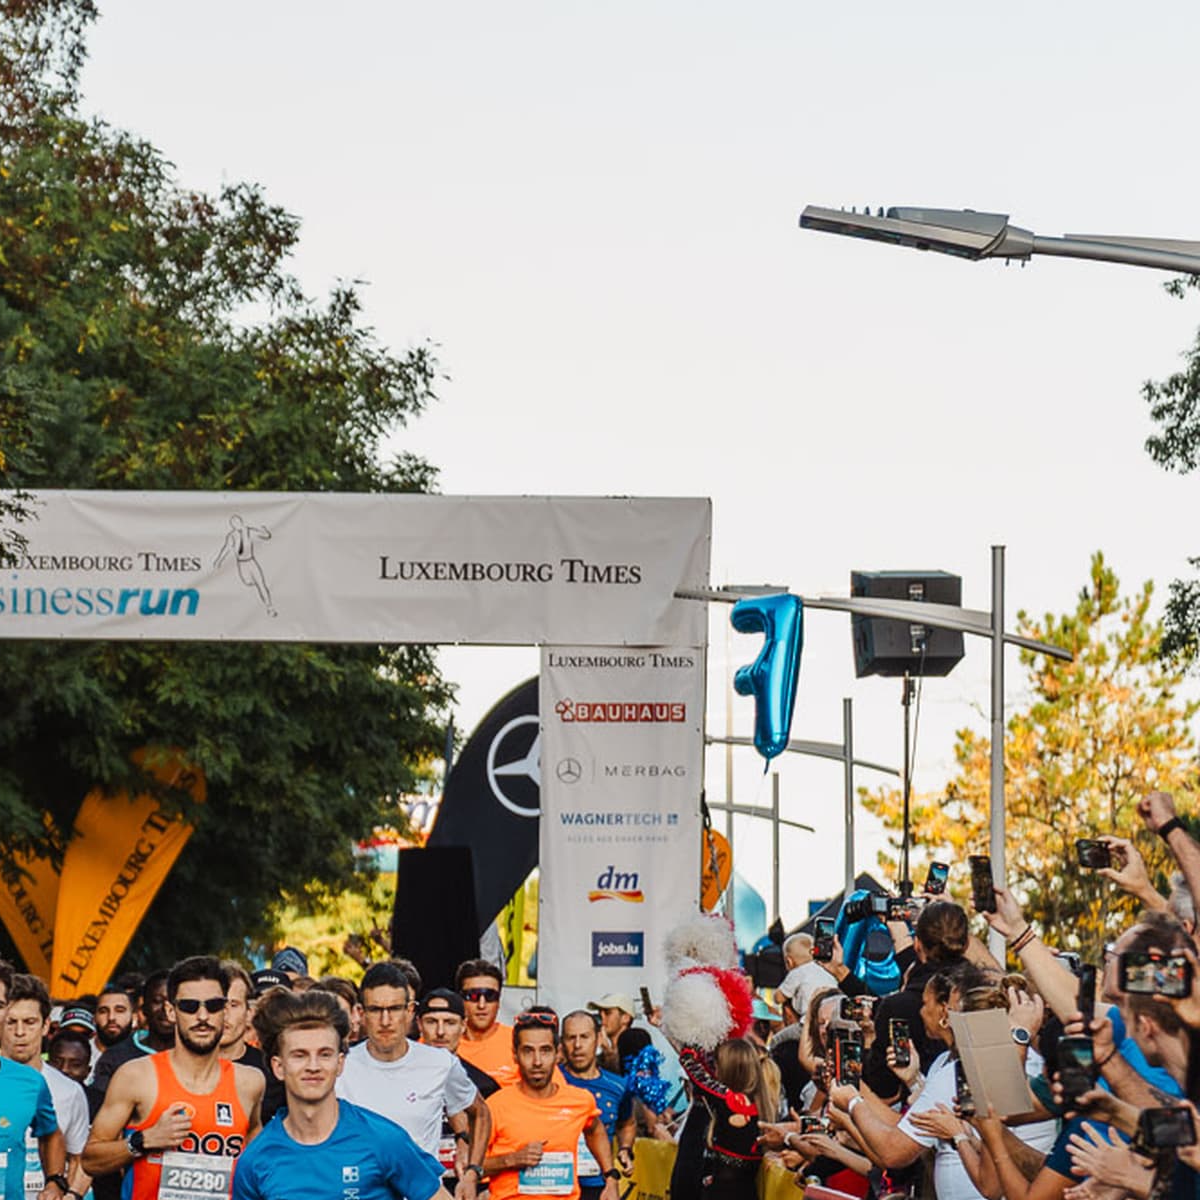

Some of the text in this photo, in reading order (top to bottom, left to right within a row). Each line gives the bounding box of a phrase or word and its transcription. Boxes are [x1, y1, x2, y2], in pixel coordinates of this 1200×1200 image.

[138, 551, 201, 572] TIMES
[379, 556, 641, 584] LUXEMBOURG TIMES
[549, 653, 694, 668] LUXEMBOURG TIMES
[577, 705, 685, 720] BAUHAUS
[604, 765, 686, 777] MERBAG
[560, 813, 662, 826] WAGNERTECH
[597, 865, 639, 890] dm
[59, 836, 156, 988] LUXEMBOURG
[597, 941, 639, 957] jobs.lu
[167, 1169, 226, 1191] 26280
[525, 1166, 570, 1179] Anthony
